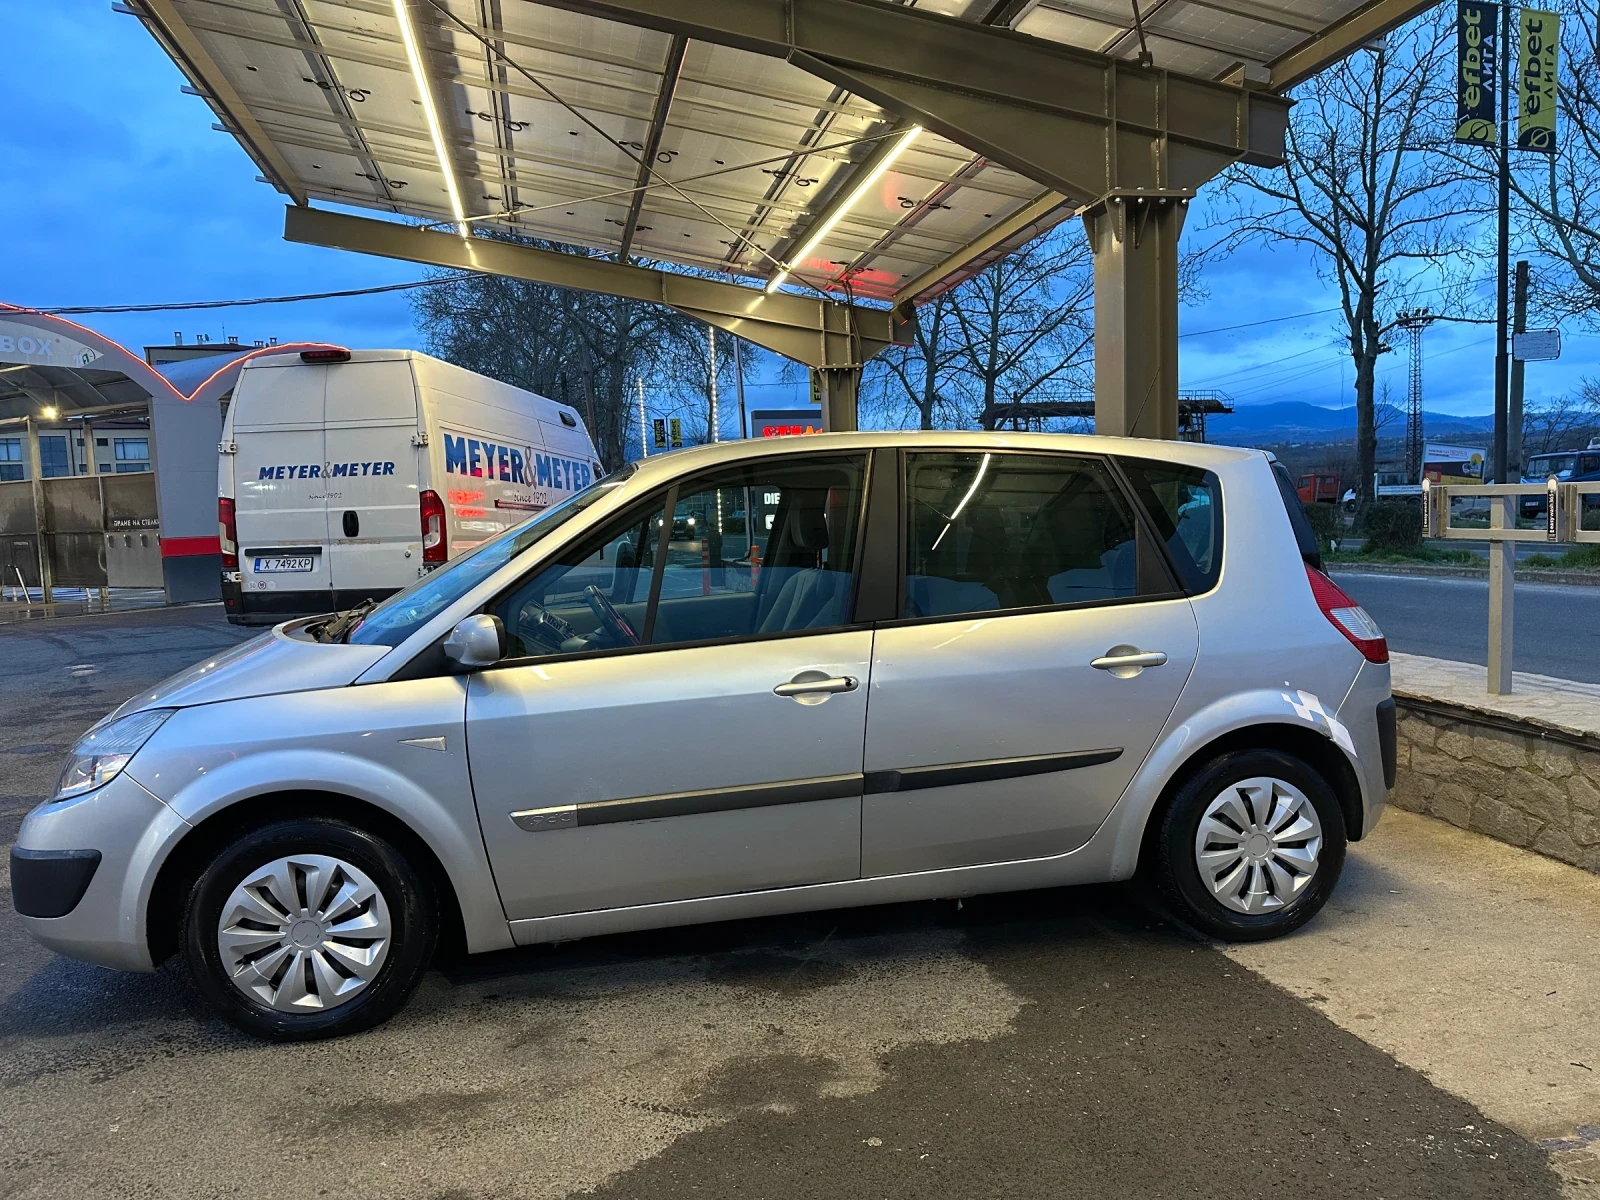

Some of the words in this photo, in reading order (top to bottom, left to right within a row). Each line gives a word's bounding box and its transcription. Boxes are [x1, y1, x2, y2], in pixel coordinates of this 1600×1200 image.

[1462, 8, 1481, 109] efbet
[1482, 34, 1495, 92] ЛИГА
[1523, 17, 1543, 116] efbet
[1543, 43, 1555, 100] ЛИГА
[259, 461, 395, 480] MEYER&MEYER
[514, 490, 532, 504] since
[532, 491, 548, 504] 1902
